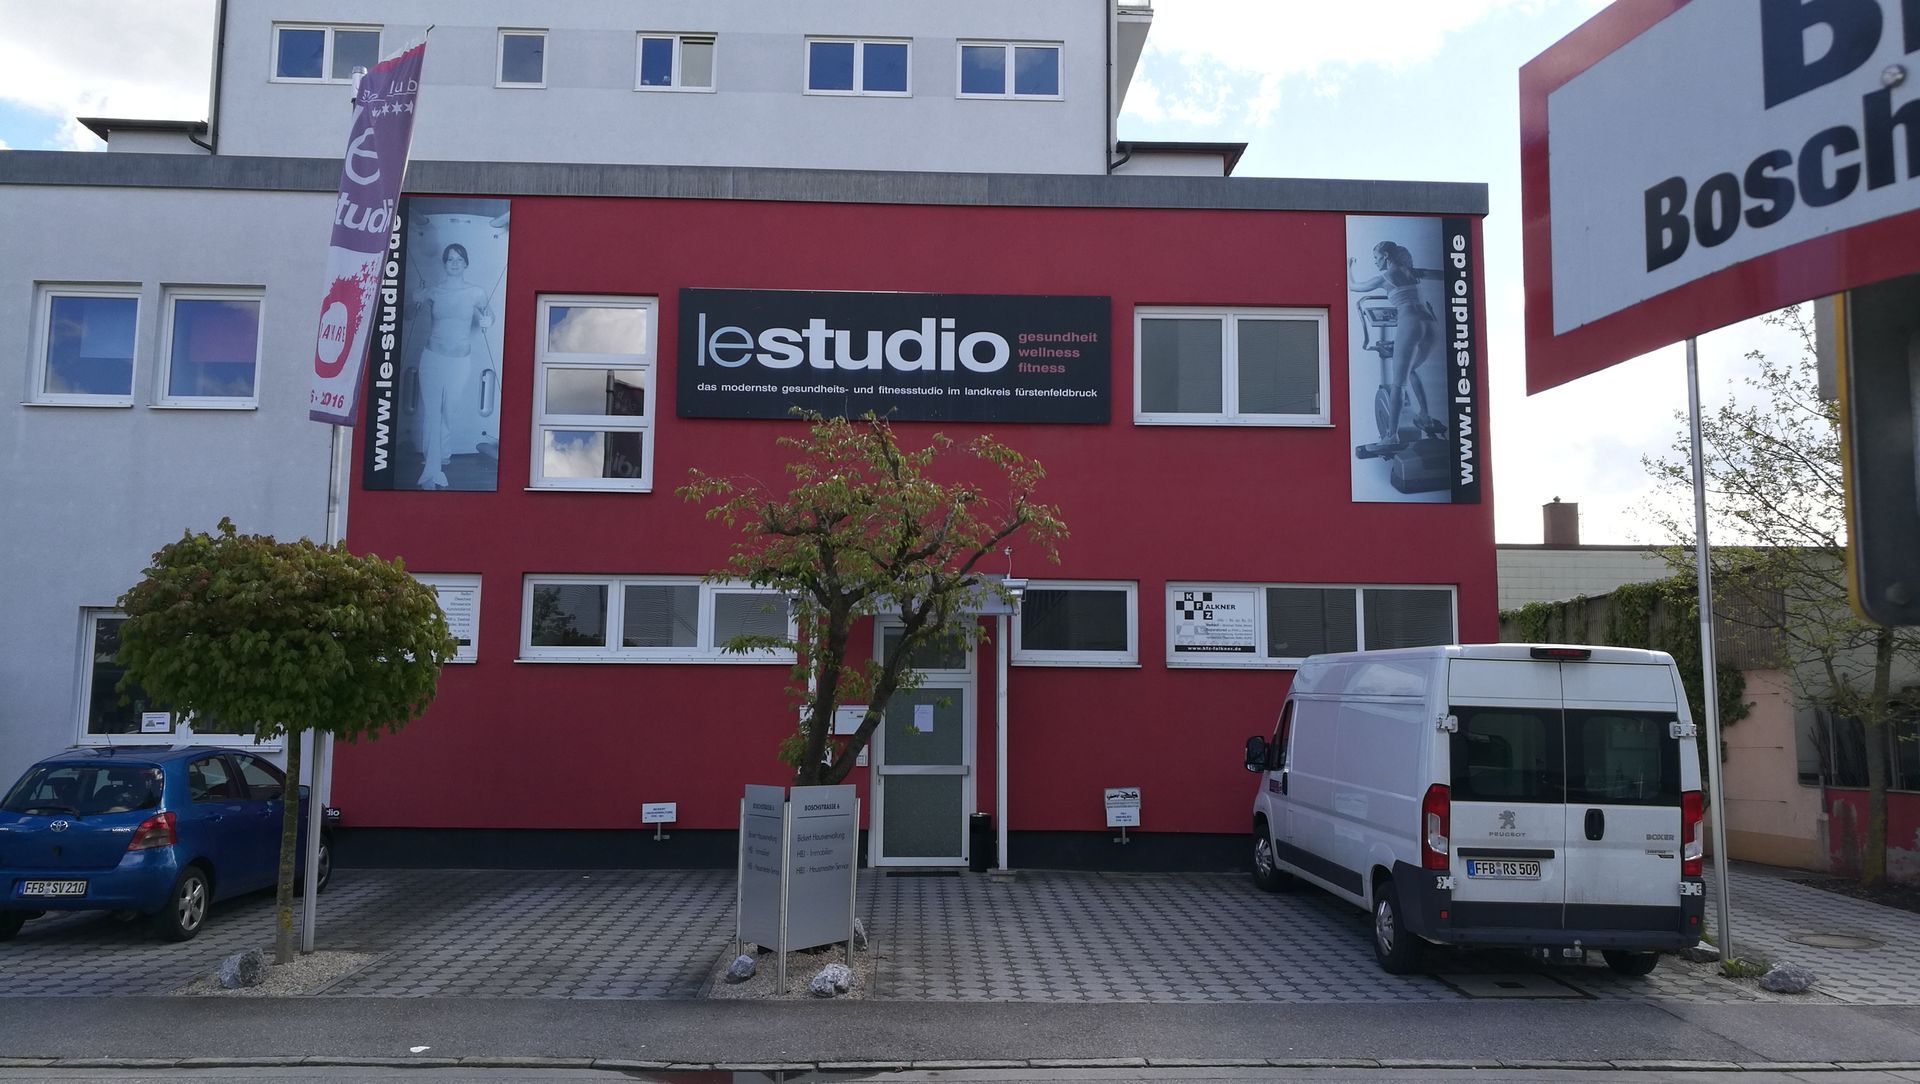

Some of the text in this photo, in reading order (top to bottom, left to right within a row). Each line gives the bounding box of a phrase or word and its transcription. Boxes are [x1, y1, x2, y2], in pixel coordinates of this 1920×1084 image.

[1760, 0, 1920, 110] B
[1018, 332, 1098, 343] gesundheit
[1018, 347, 1080, 358] wellness
[1450, 234, 1474, 485] www.le-studio.de
[1018, 362, 1066, 373] fitness
[697, 382, 1098, 397] das modernste gesundheits- und fitnessstudio im landkreis fürstenfeldbruck
